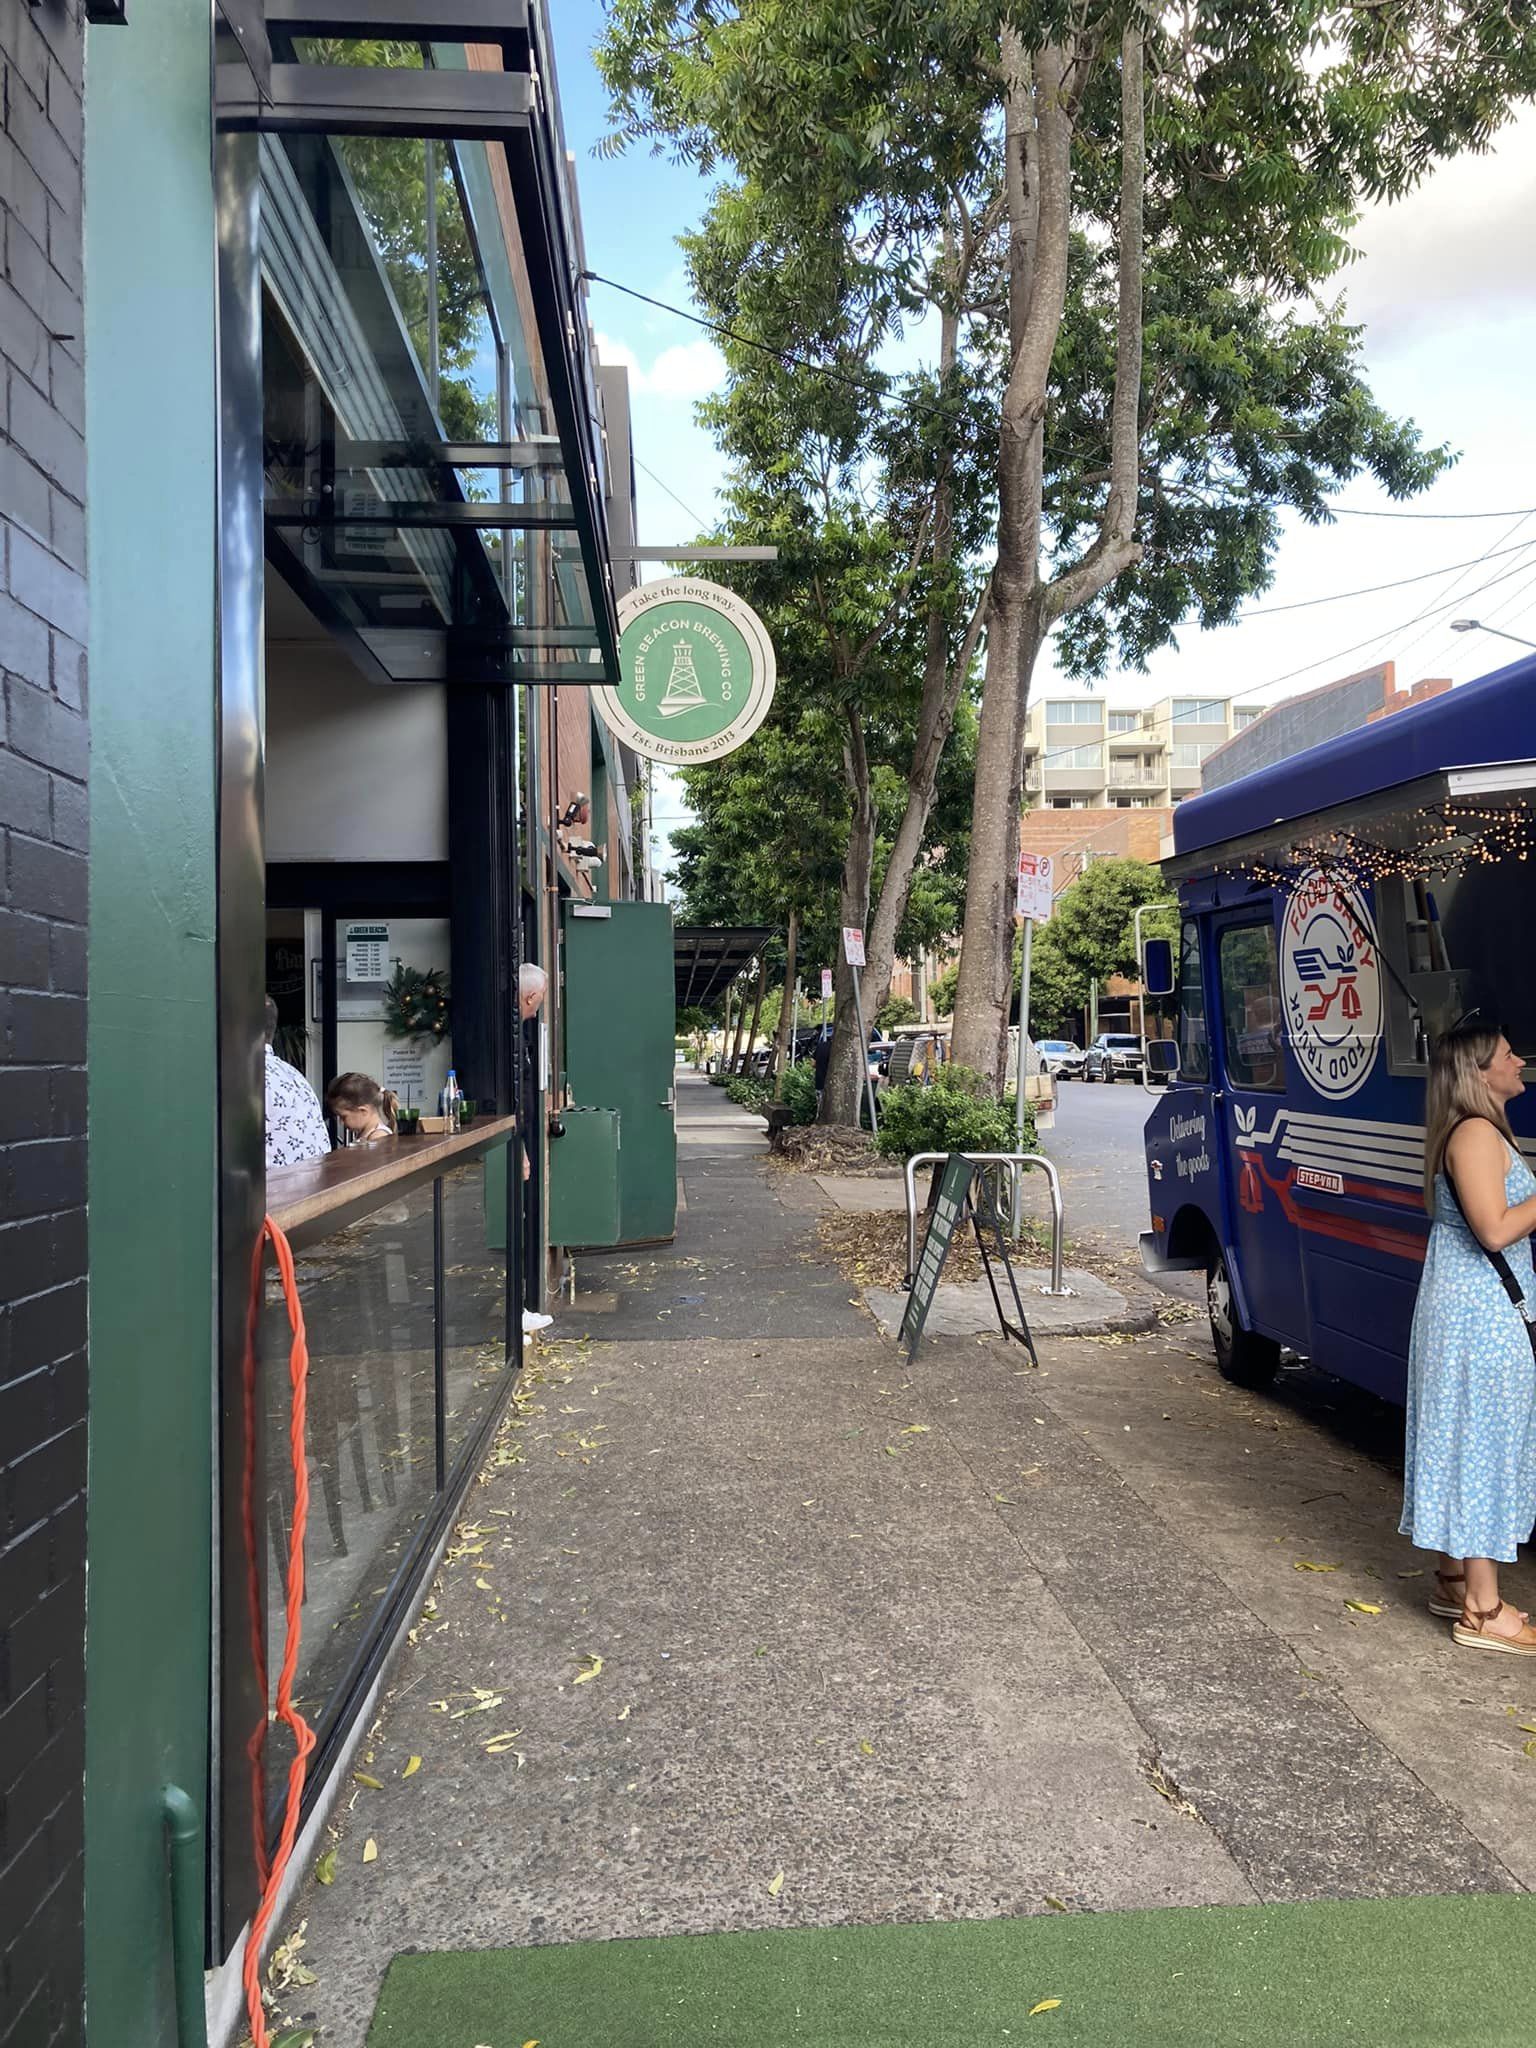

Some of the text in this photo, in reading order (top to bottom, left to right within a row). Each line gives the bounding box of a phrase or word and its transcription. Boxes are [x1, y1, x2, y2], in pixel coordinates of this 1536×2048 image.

[631, 585, 737, 612] Take the long way.
[635, 619, 732, 702] GREEN BEACON BREWING CO
[631, 730, 736, 758] Est. Brisbane 2013
[1290, 991, 1366, 1081] FOOD TRUCK
[1169, 1110, 1206, 1143] Delivering
[1175, 1145, 1211, 1184] the goods
